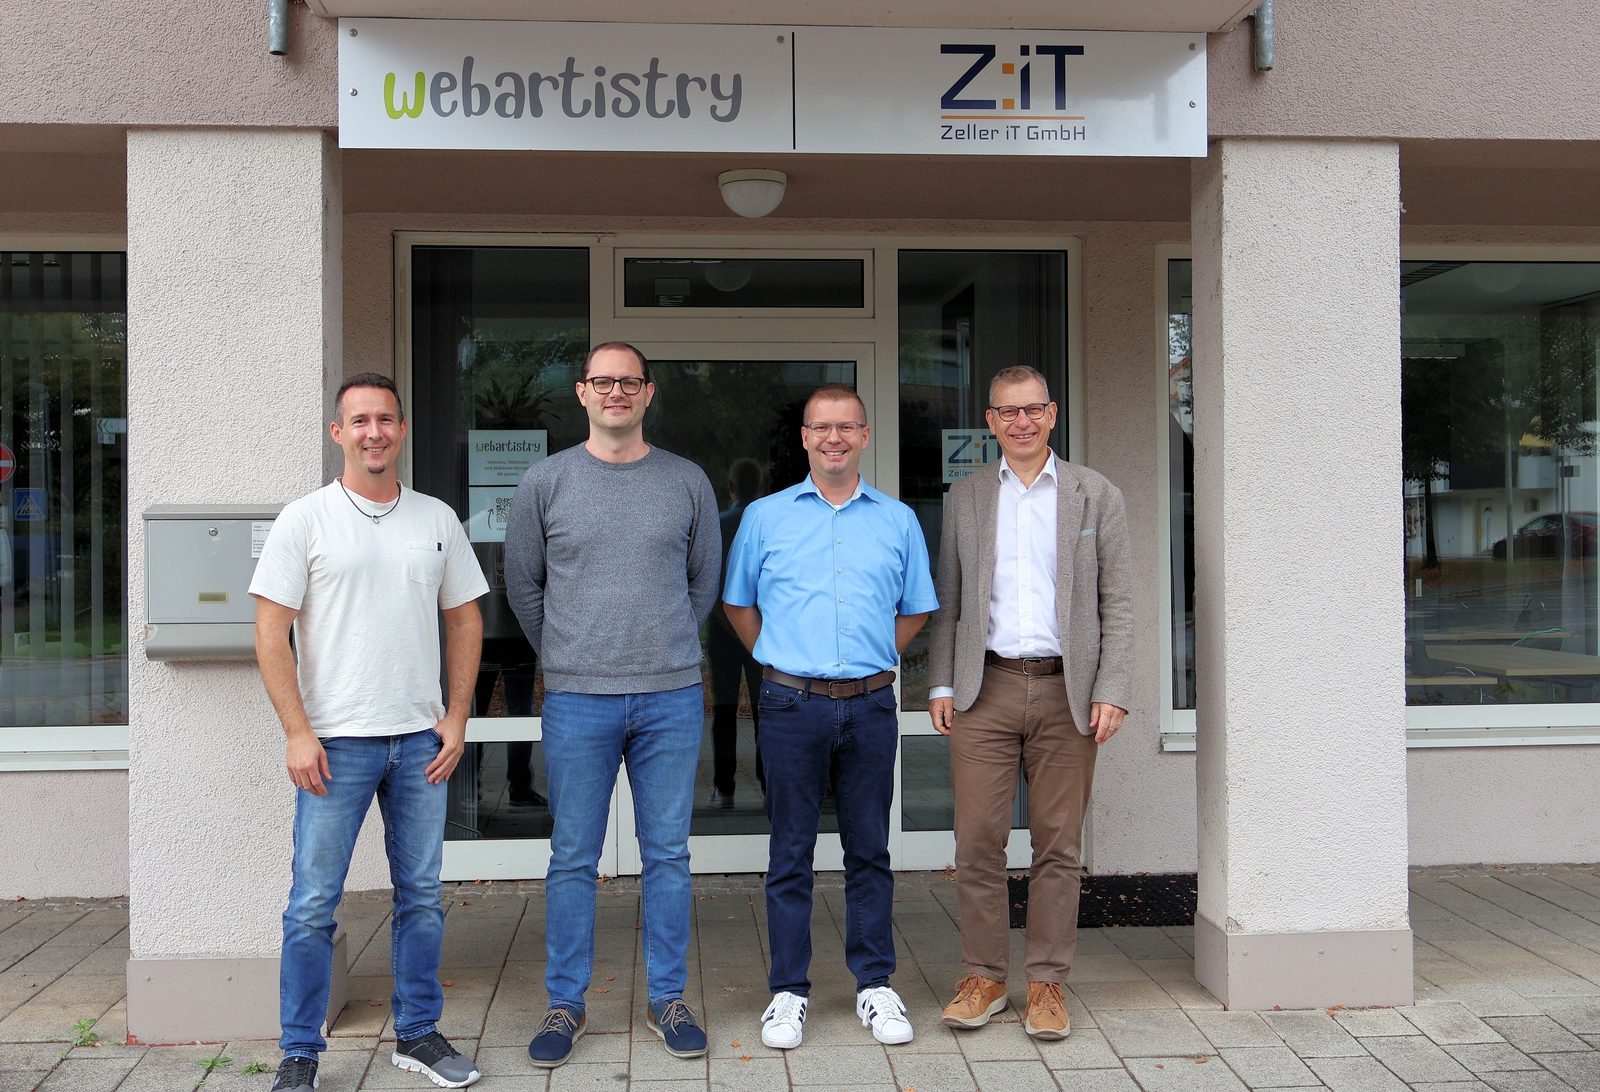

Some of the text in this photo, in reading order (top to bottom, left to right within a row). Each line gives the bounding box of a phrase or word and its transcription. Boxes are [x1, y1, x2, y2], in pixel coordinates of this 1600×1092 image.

[383, 55, 743, 122] webartistry
[940, 124, 1086, 141] Zeller iT GmbH
[476, 440, 541, 453] webartistry
